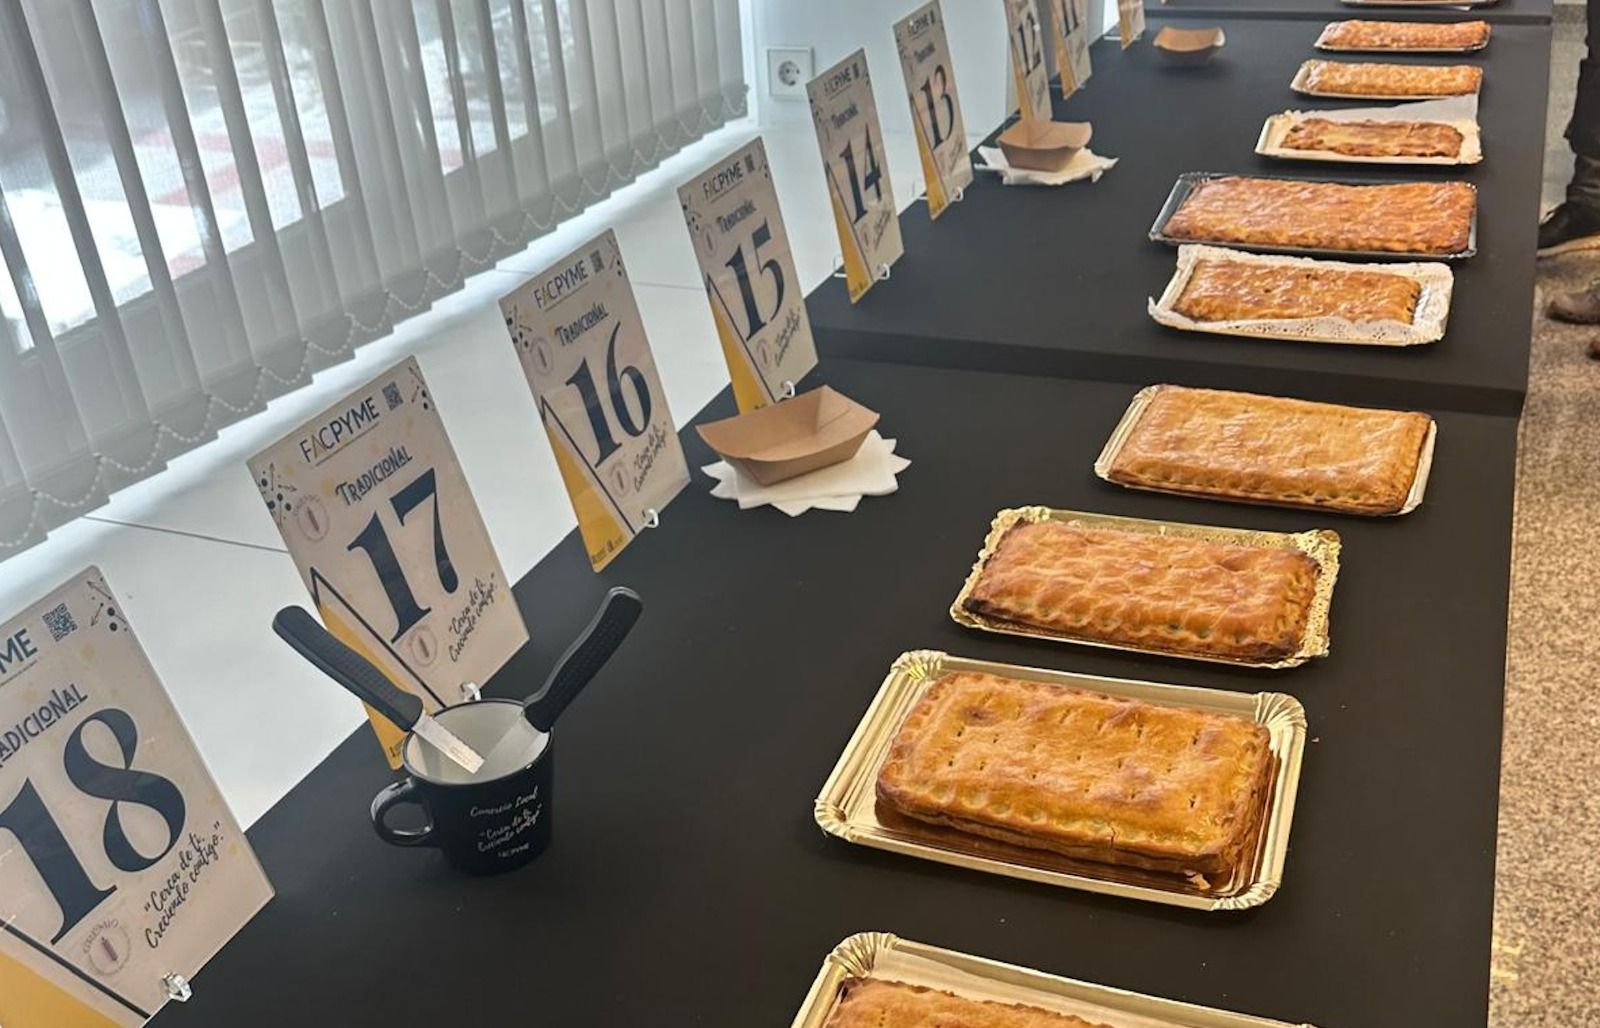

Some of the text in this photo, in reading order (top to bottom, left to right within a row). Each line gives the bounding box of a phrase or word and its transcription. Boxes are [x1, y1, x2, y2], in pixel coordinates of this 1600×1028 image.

[1018, 12, 1041, 78] 12
[920, 64, 954, 150] 13
[839, 122, 882, 224] 14
[533, 260, 588, 309] FACPYME
[725, 216, 785, 341] 15
[299, 396, 380, 463] FACPYME
[565, 320, 652, 469] 16
[335, 445, 413, 506] TRADICIONAL
[347, 467, 458, 645] 17
[0, 683, 88, 768] ADICIONAL
[0, 708, 186, 945] 18
[143, 833, 206, 912] "Cerca de ti.
[145, 821, 224, 949] Creciendo contigo."
